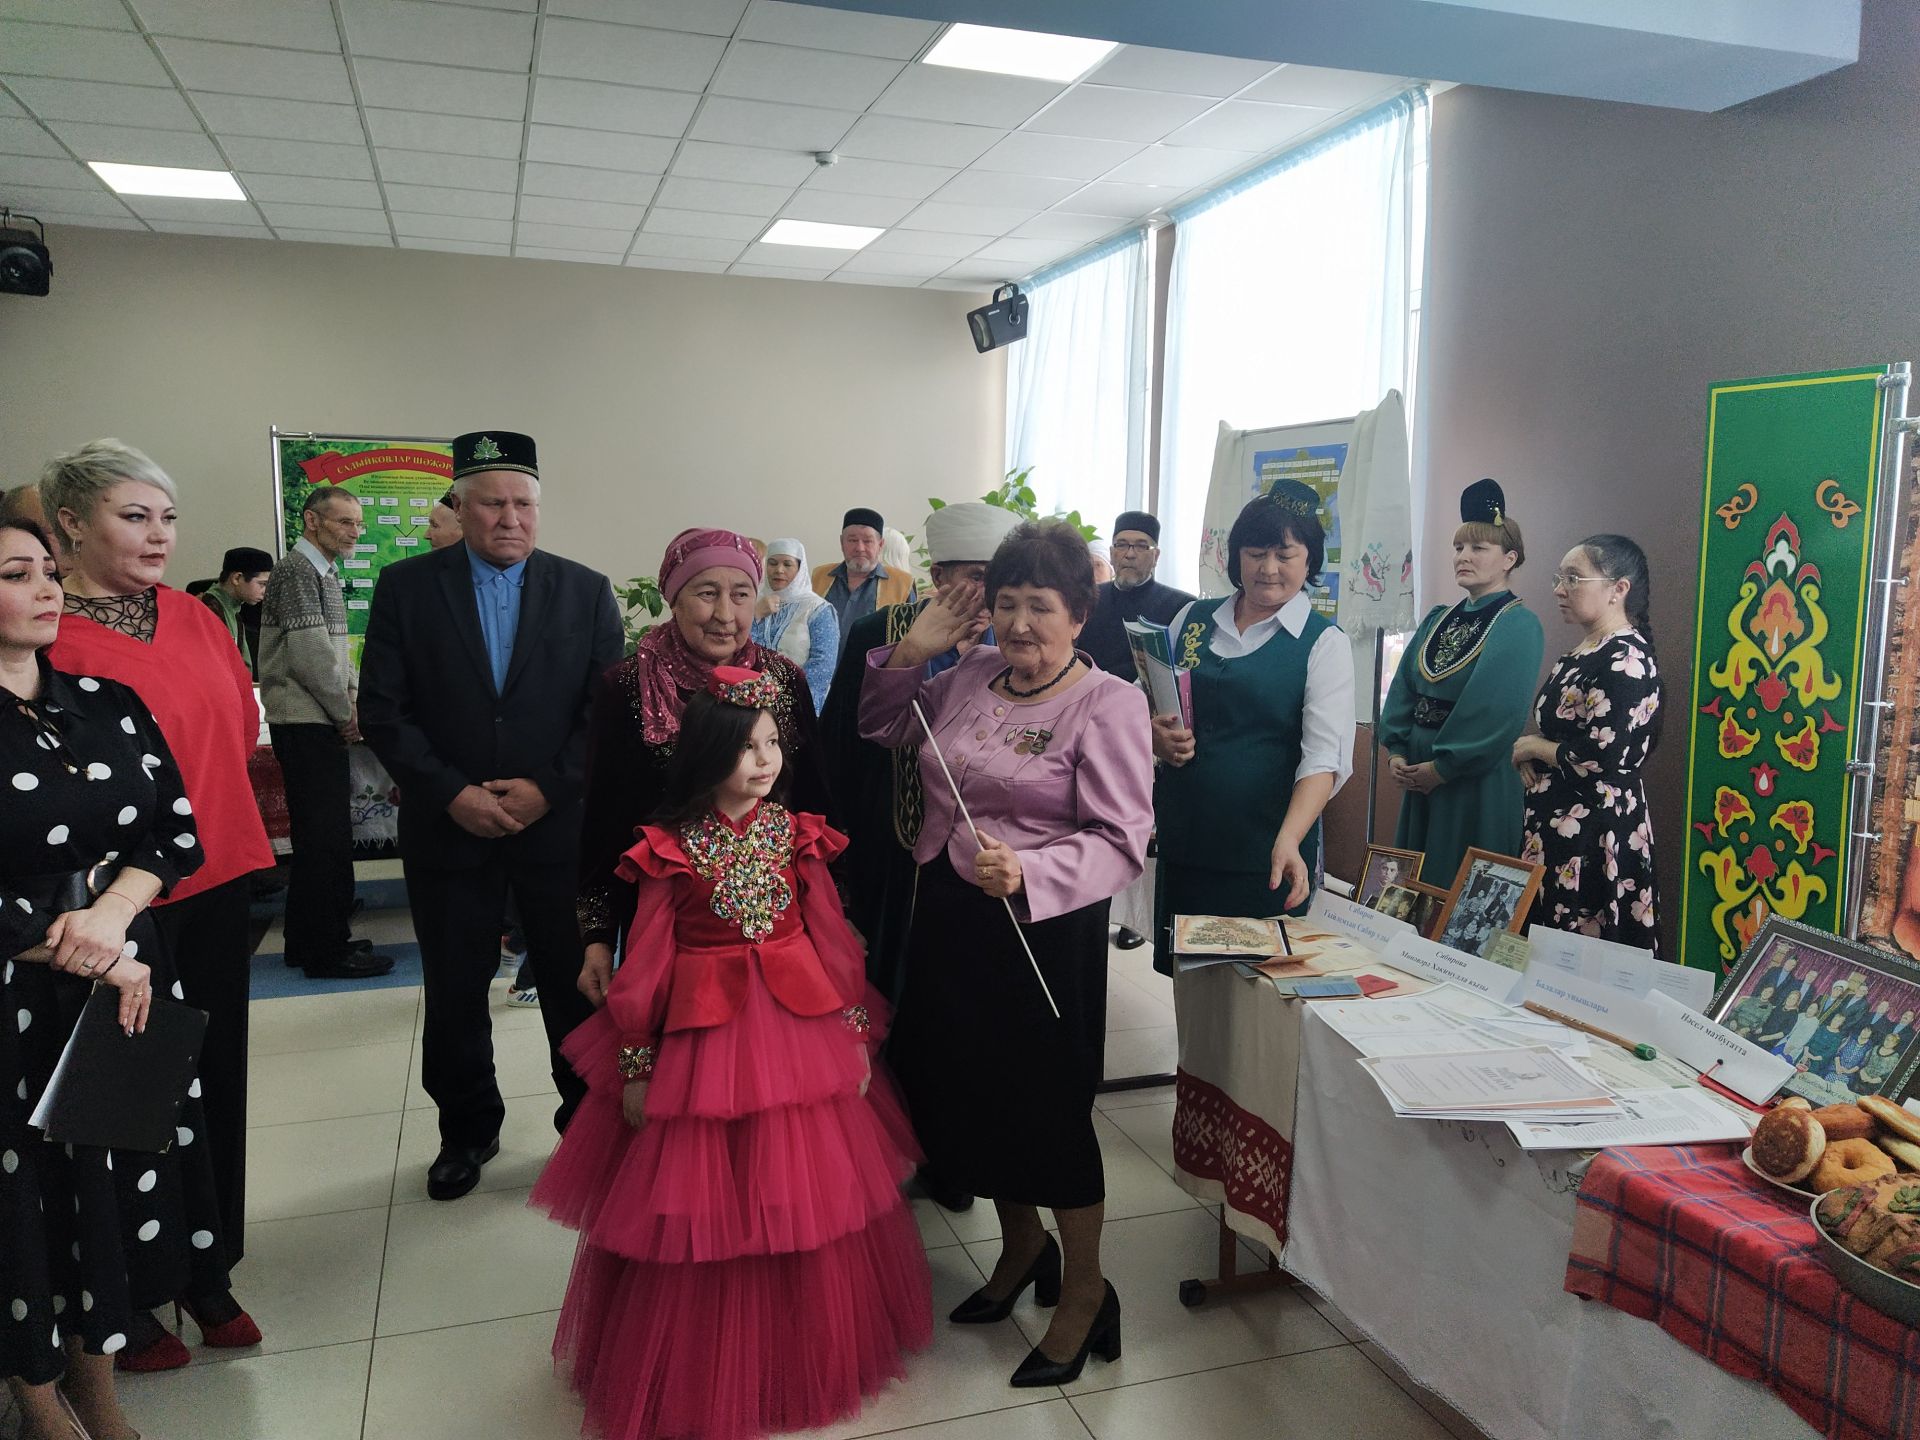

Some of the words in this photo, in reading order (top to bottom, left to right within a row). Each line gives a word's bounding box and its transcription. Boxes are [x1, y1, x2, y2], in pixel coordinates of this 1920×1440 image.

[337, 455, 411, 474] САДЫЙКОВЛАР
[1435, 951, 1468, 968] Сабирова
[1535, 979, 1566, 998] Балалар
[1680, 1012, 1704, 1031] Нәсел
[1705, 1027, 1748, 1057] матбугатта
